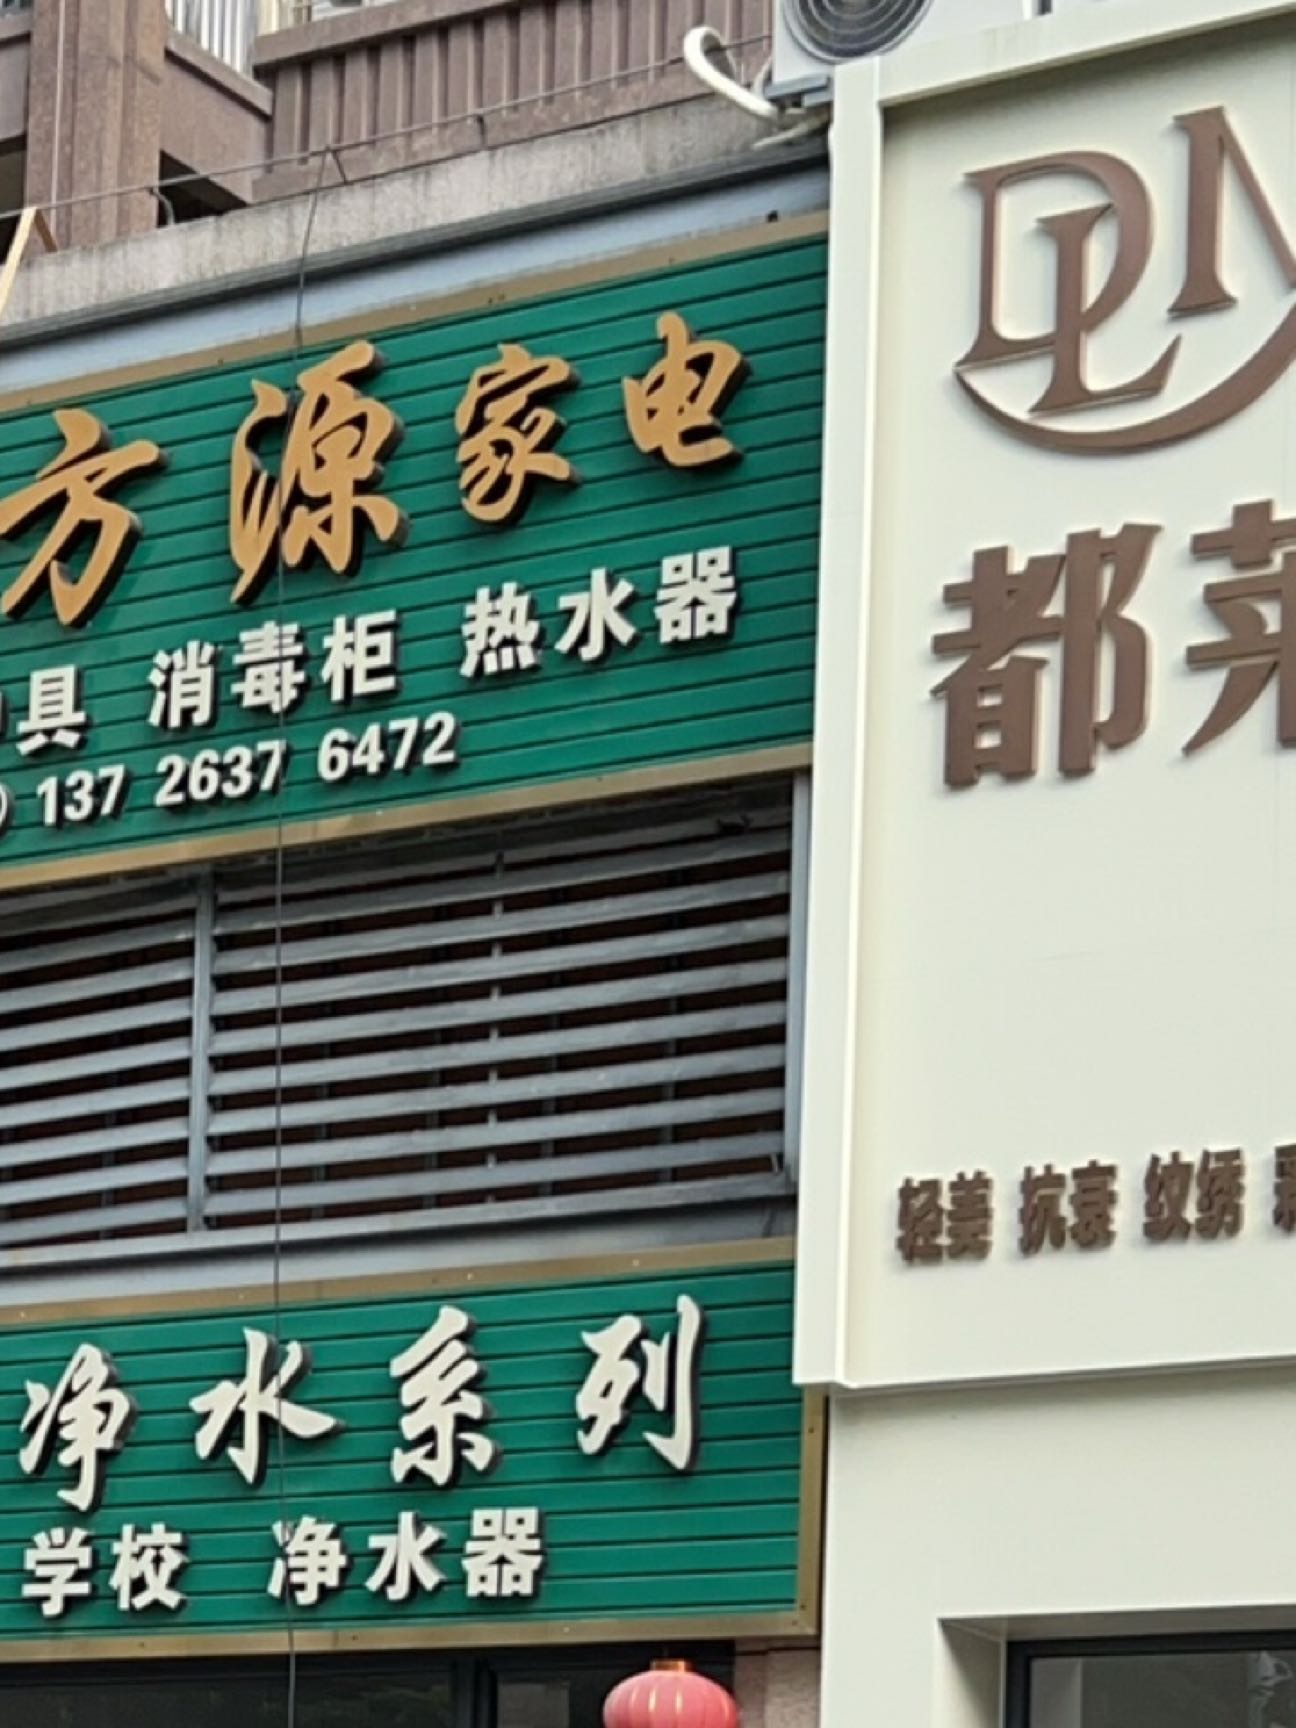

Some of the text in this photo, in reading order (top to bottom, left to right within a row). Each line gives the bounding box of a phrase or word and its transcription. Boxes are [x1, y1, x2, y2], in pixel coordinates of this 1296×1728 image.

[147, 609, 399, 728] 消毒柜
[460, 545, 740, 677] 热水器
[37, 710, 458, 826] 137 2637 6472
[1019, 1159, 1118, 1256] 抗衰
[20, 1521, 188, 1615] 学校
[267, 1505, 547, 1605] 净水器
